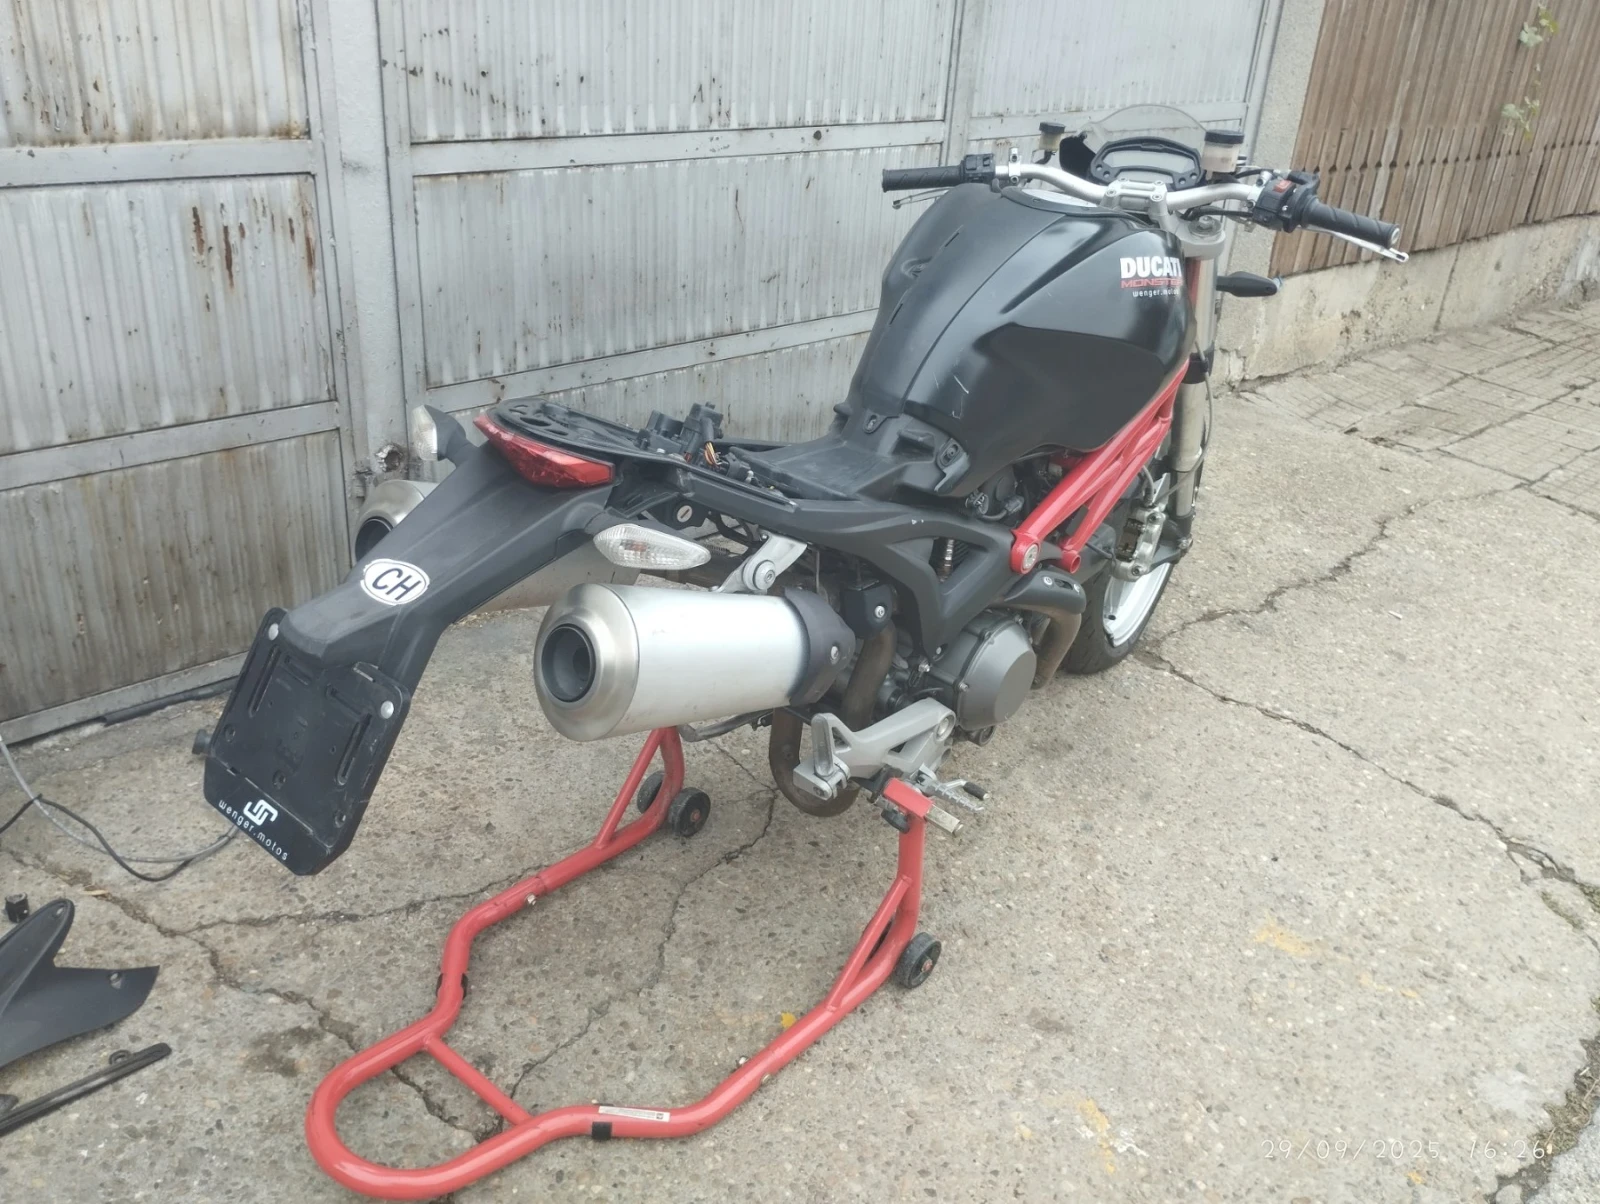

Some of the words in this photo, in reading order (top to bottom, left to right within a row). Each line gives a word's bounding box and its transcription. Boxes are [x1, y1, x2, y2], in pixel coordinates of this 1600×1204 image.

[1120, 256, 1182, 278] DUCATI
[372, 568, 421, 601] CH
[218, 800, 288, 861] wenger.motos
